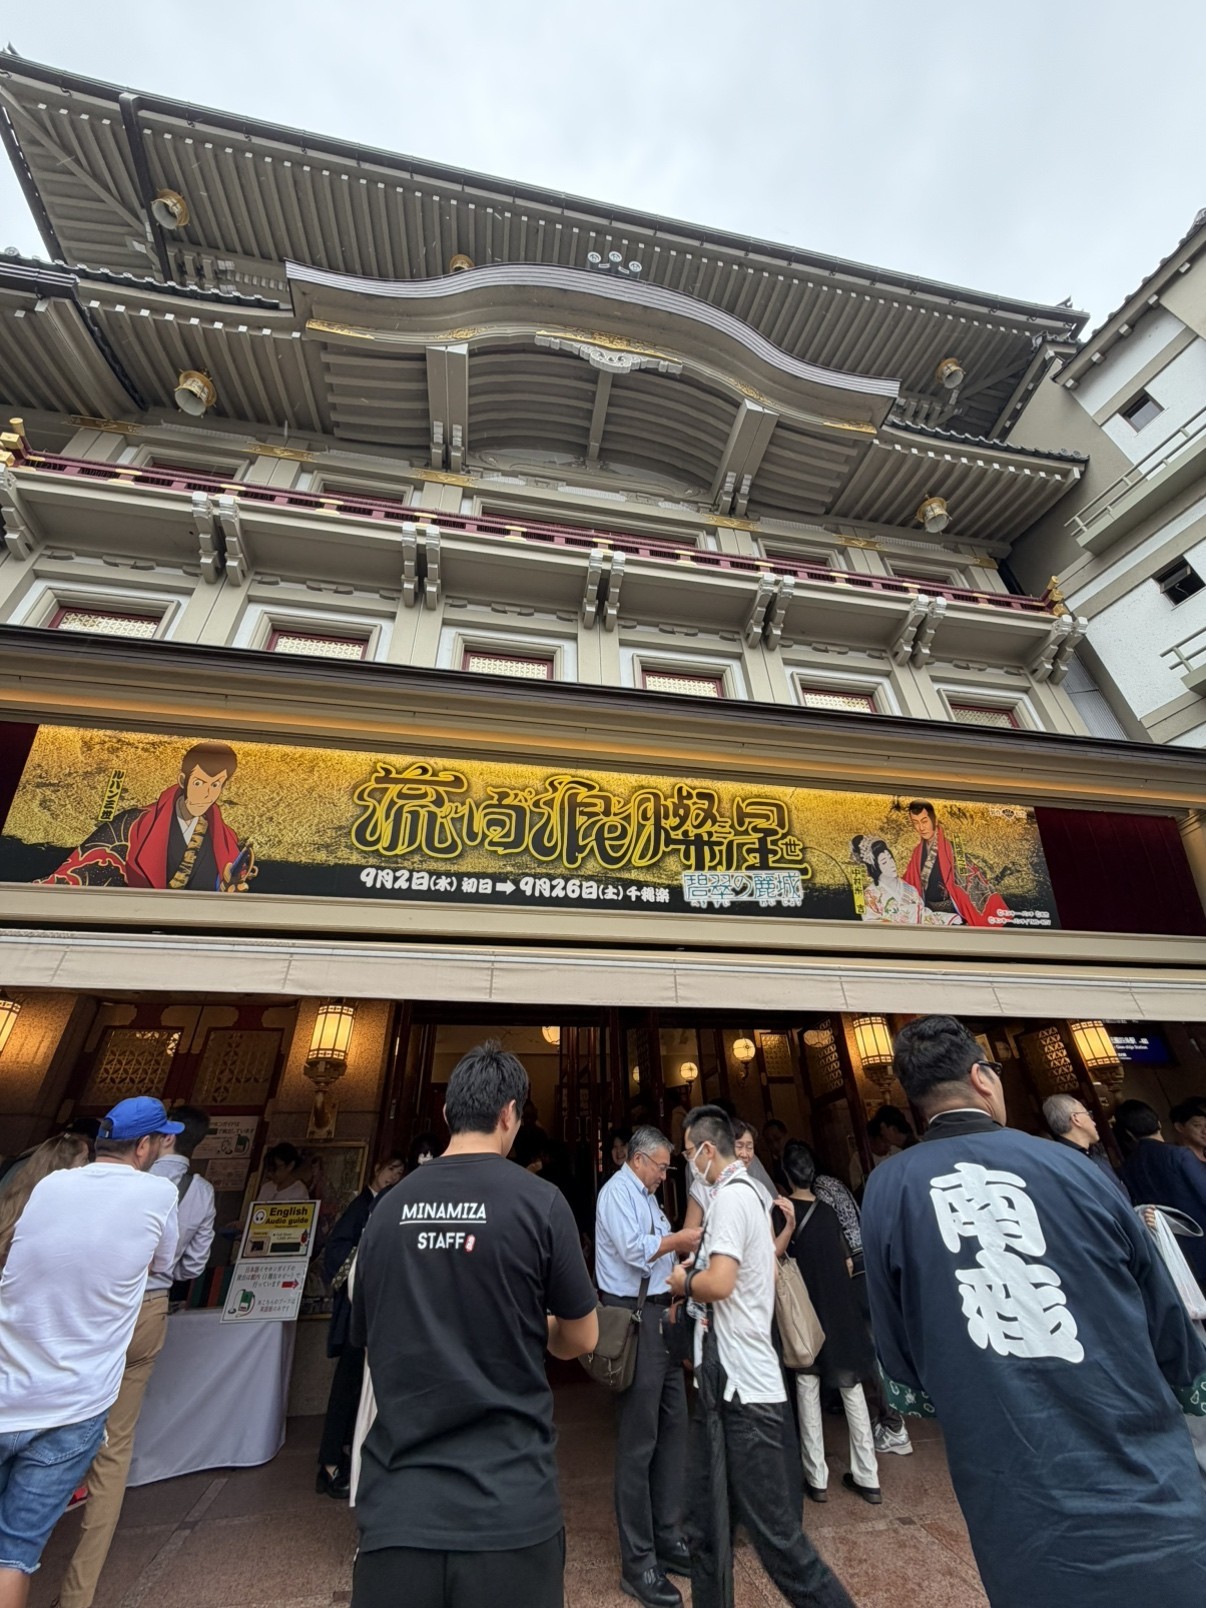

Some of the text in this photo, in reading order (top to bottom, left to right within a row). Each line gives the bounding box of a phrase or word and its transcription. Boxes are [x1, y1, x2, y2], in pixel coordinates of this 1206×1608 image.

[100, 769, 125, 820] ルパン三世
[360, 867, 457, 891] 9月2日(水)
[462, 878, 492, 893] 初日
[519, 876, 623, 900] 9月26日(土)
[683, 871, 802, 899] 碧翠の麗城
[269, 1206, 308, 1218] English
[402, 1202, 487, 1219] MINAMIZA
[265, 1217, 309, 1226] Audio guide
[417, 1232, 465, 1250] STAFF
